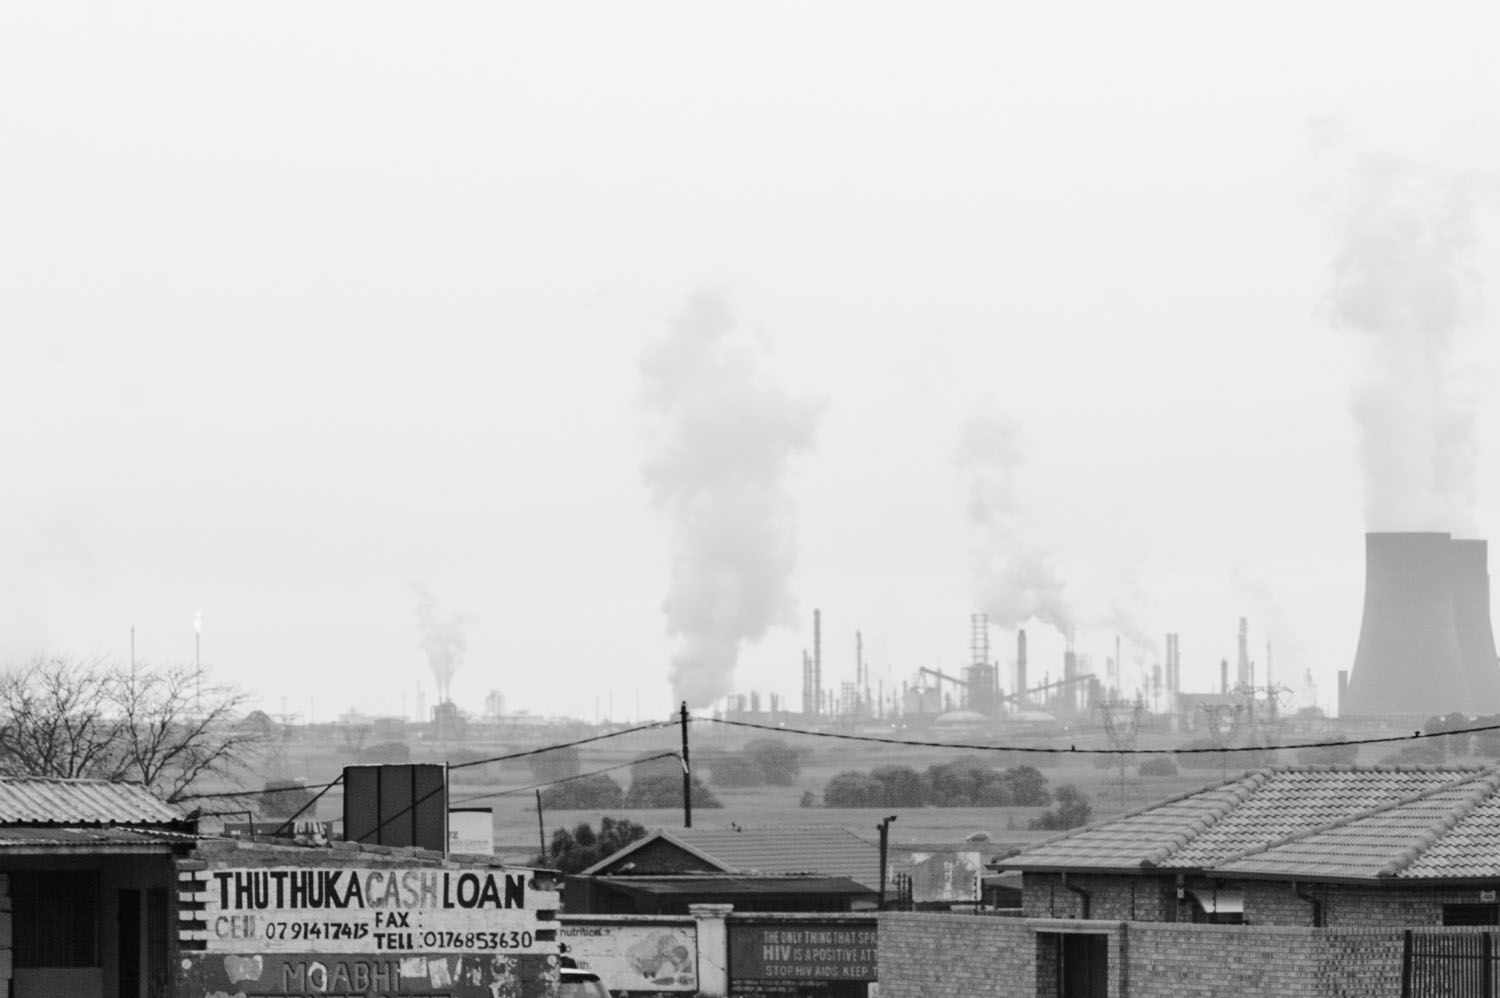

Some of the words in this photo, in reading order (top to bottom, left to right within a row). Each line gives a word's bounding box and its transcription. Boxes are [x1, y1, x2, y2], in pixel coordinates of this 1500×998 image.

[213, 871, 364, 910] THUTHUKA
[365, 871, 437, 909] CASH
[443, 873, 525, 909] LOAN
[375, 911, 410, 928] FAX
[763, 931, 779, 944] THE
[781, 931, 802, 944] ONLY
[804, 931, 831, 944] THING
[833, 931, 856, 944] THAT
[858, 931, 878, 944] SPR
[763, 945, 791, 961] HIV
[793, 949, 803, 961] IS
[804, 949, 811, 961] A
[812, 949, 857, 961] POSITIVE
[860, 949, 879, 961] ATT
[765, 965, 793, 977] STOP
[795, 965, 812, 977] HIV
[814, 965, 839, 977] AIDS
[842, 965, 868, 977] KEEP
